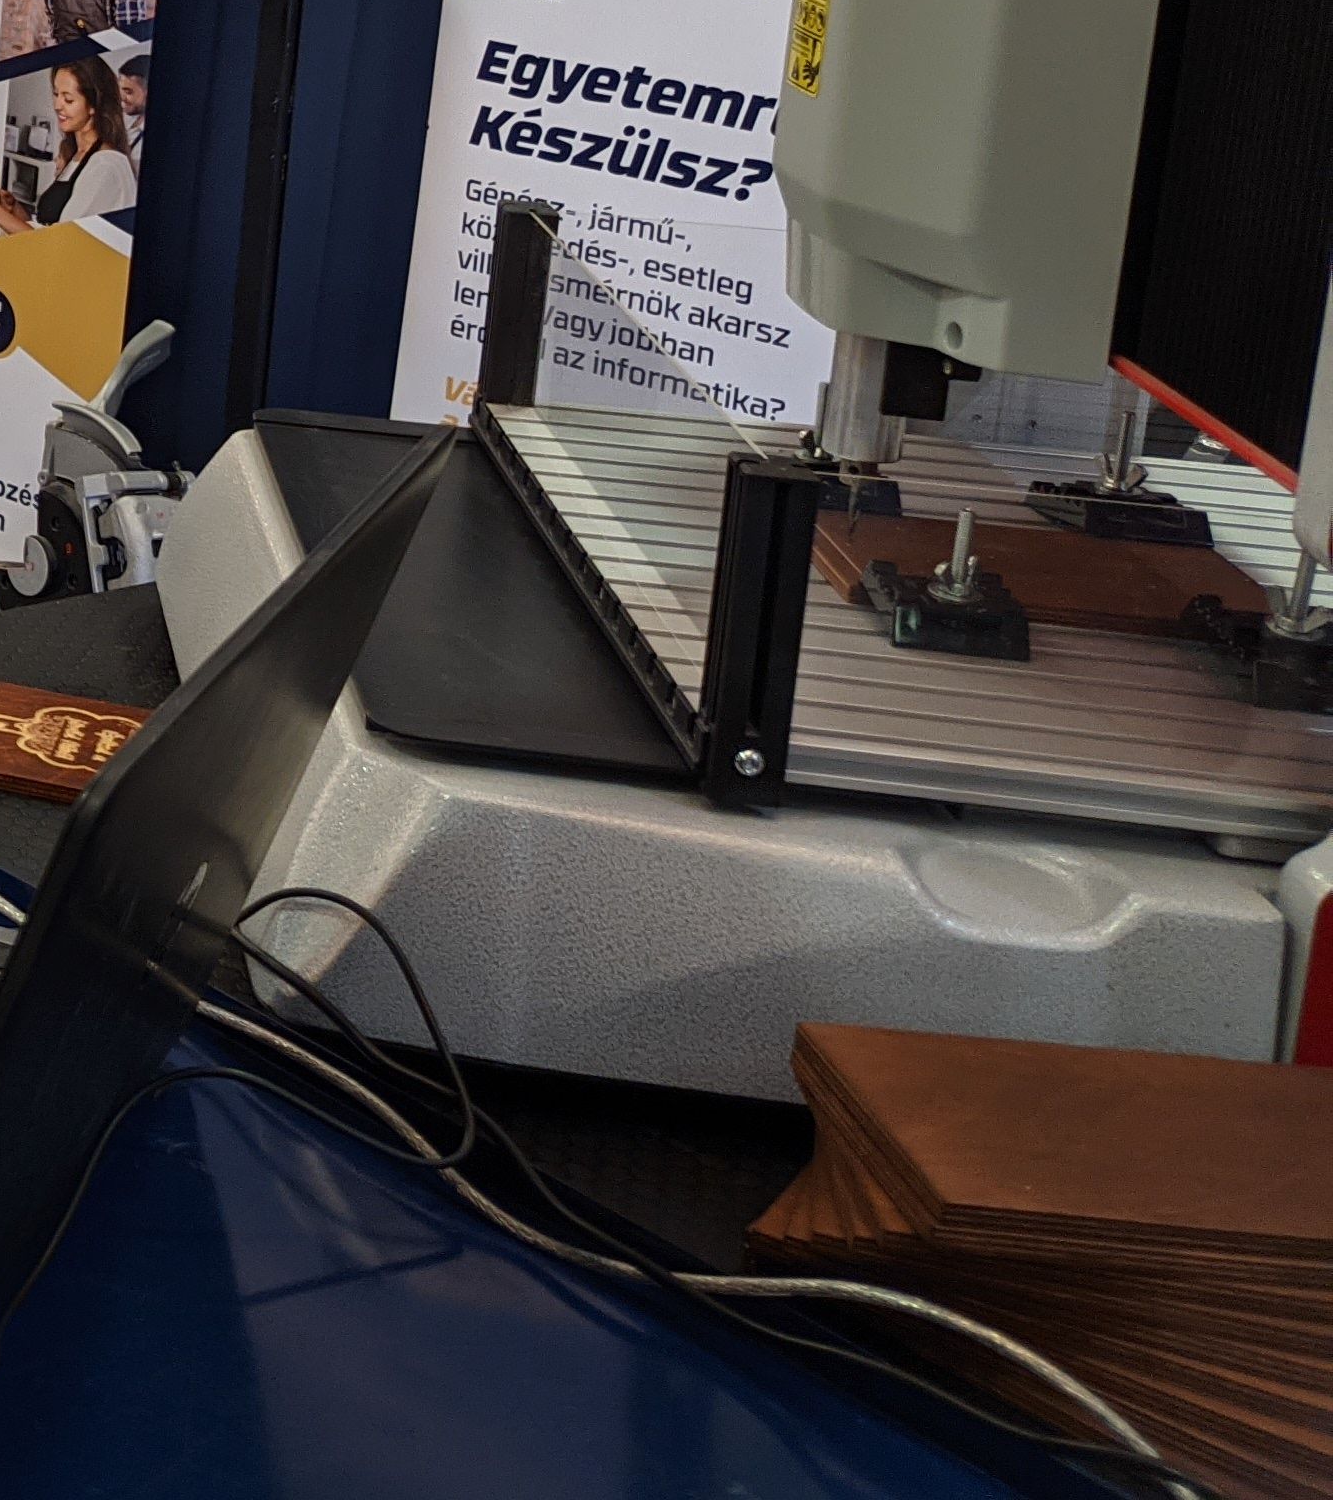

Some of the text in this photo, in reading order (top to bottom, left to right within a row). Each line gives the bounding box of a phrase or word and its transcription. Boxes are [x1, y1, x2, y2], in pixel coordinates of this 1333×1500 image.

[476, 39, 777, 135] Egyetemr
[468, 106, 775, 203] Készülsz?
[588, 203, 693, 253] jármű-,
[643, 256, 754, 306] esetleg
[608, 323, 715, 368] jobban
[686, 303, 791, 350] akarsz
[553, 345, 787, 422] az informatika?
